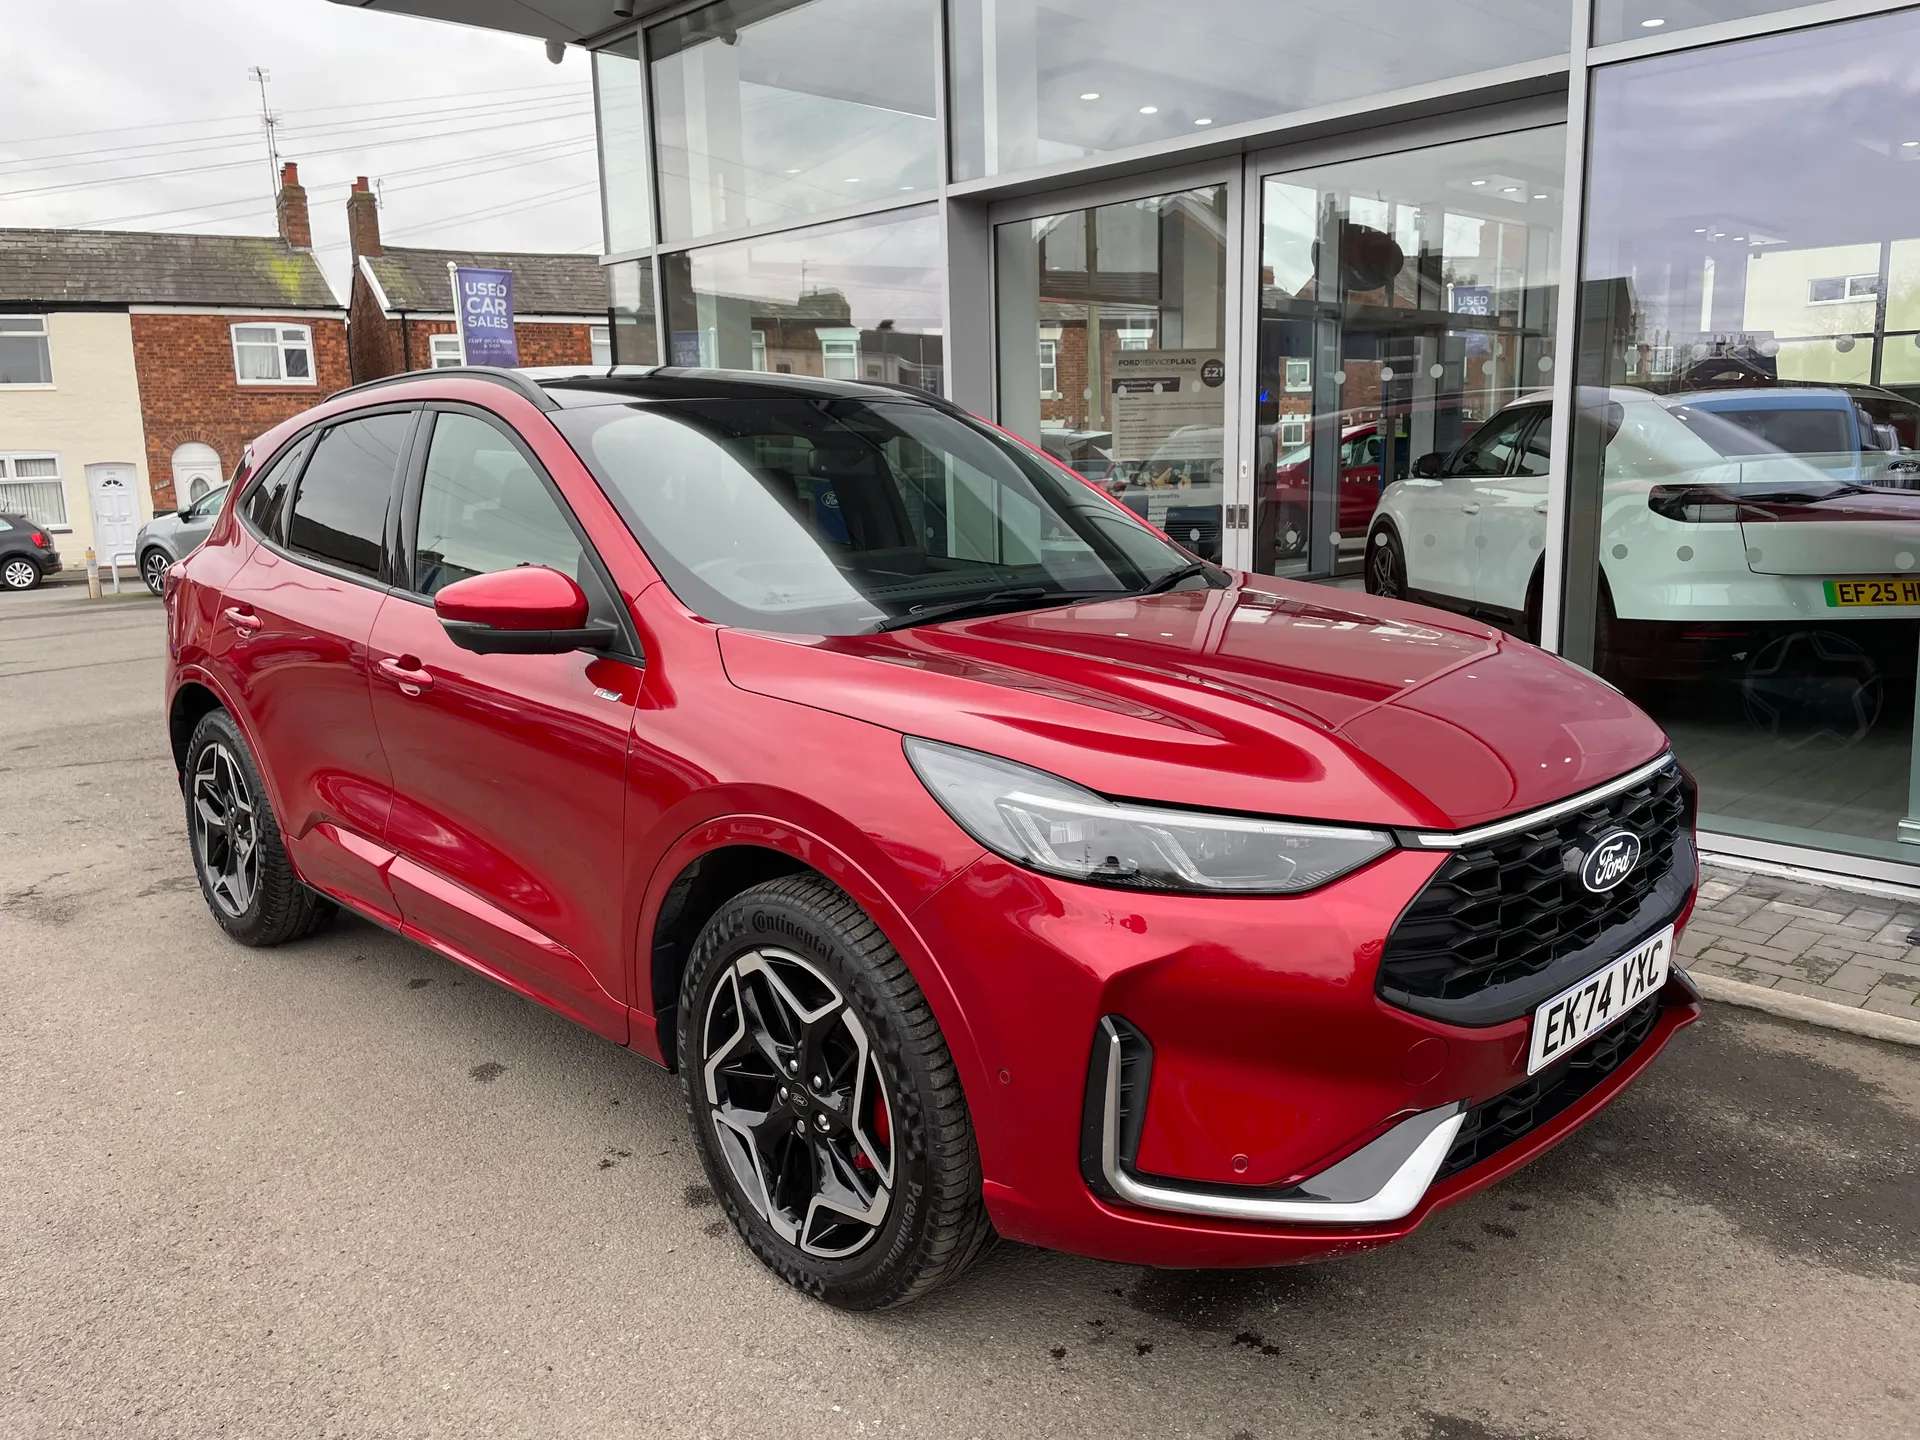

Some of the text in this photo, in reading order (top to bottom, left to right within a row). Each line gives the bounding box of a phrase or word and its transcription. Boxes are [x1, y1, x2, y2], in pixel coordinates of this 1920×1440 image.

[465, 282, 507, 297] USED
[466, 297, 507, 315] CAR
[1457, 295, 1488, 305] USED
[468, 315, 509, 329] SALES
[1838, 582, 1920, 603] EF25 H
[1594, 841, 1632, 886] Ford
[752, 910, 835, 963] Continental
[1542, 939, 1664, 1058] EK74 YXC
